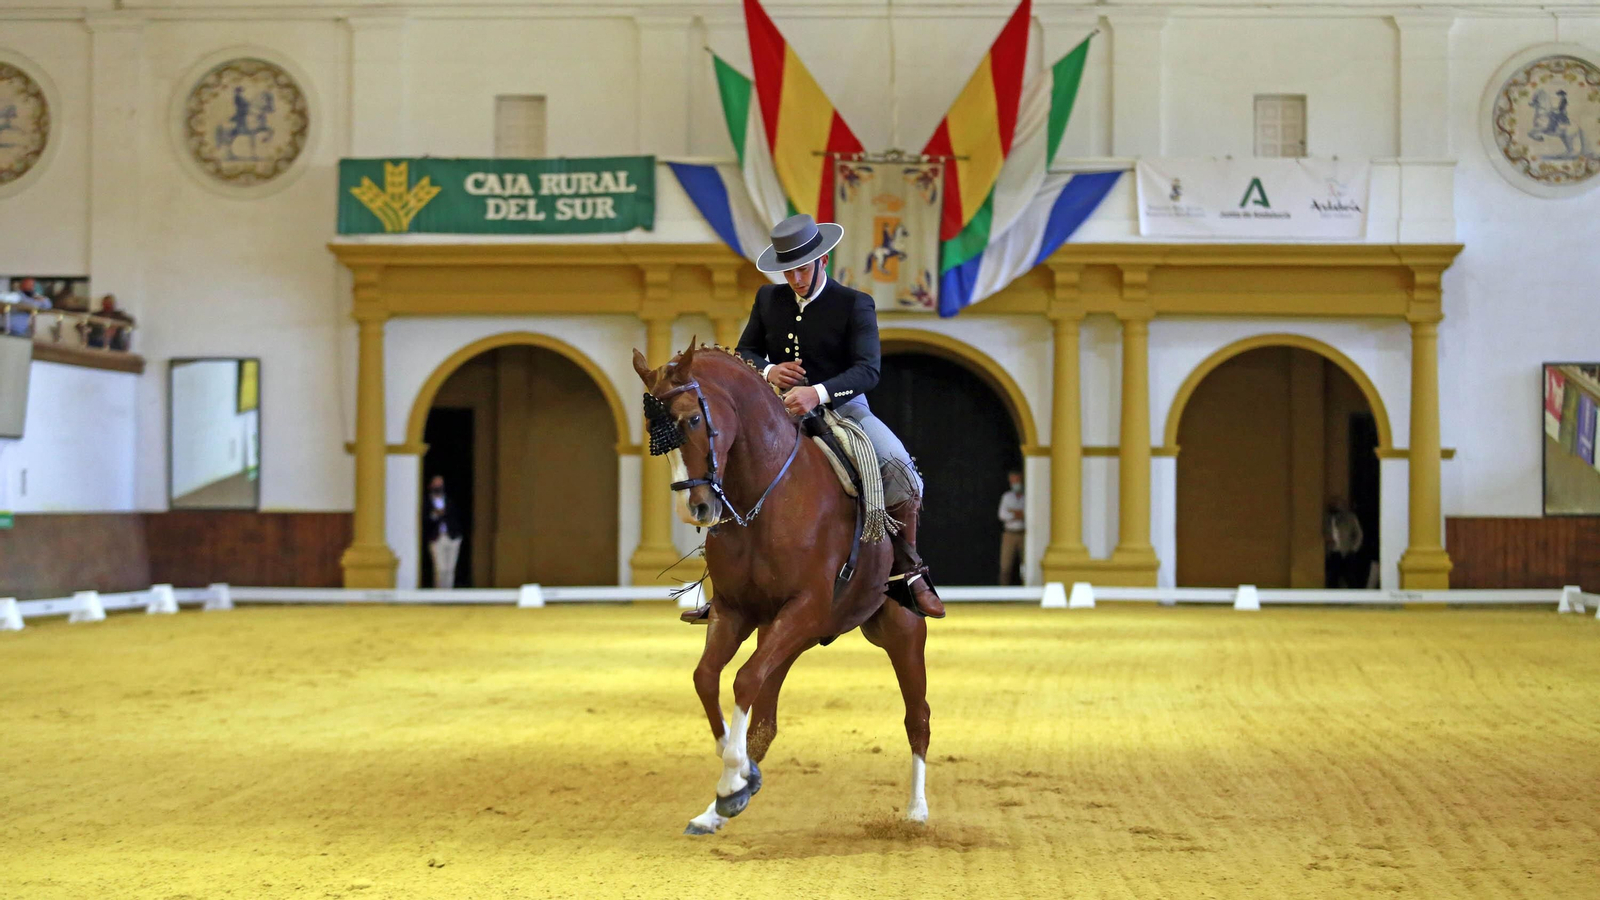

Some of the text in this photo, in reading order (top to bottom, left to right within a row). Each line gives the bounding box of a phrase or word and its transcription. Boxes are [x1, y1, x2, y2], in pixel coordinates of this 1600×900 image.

[464, 171, 637, 196] CAJA RURAL
[485, 196, 617, 221] DEL SUR
